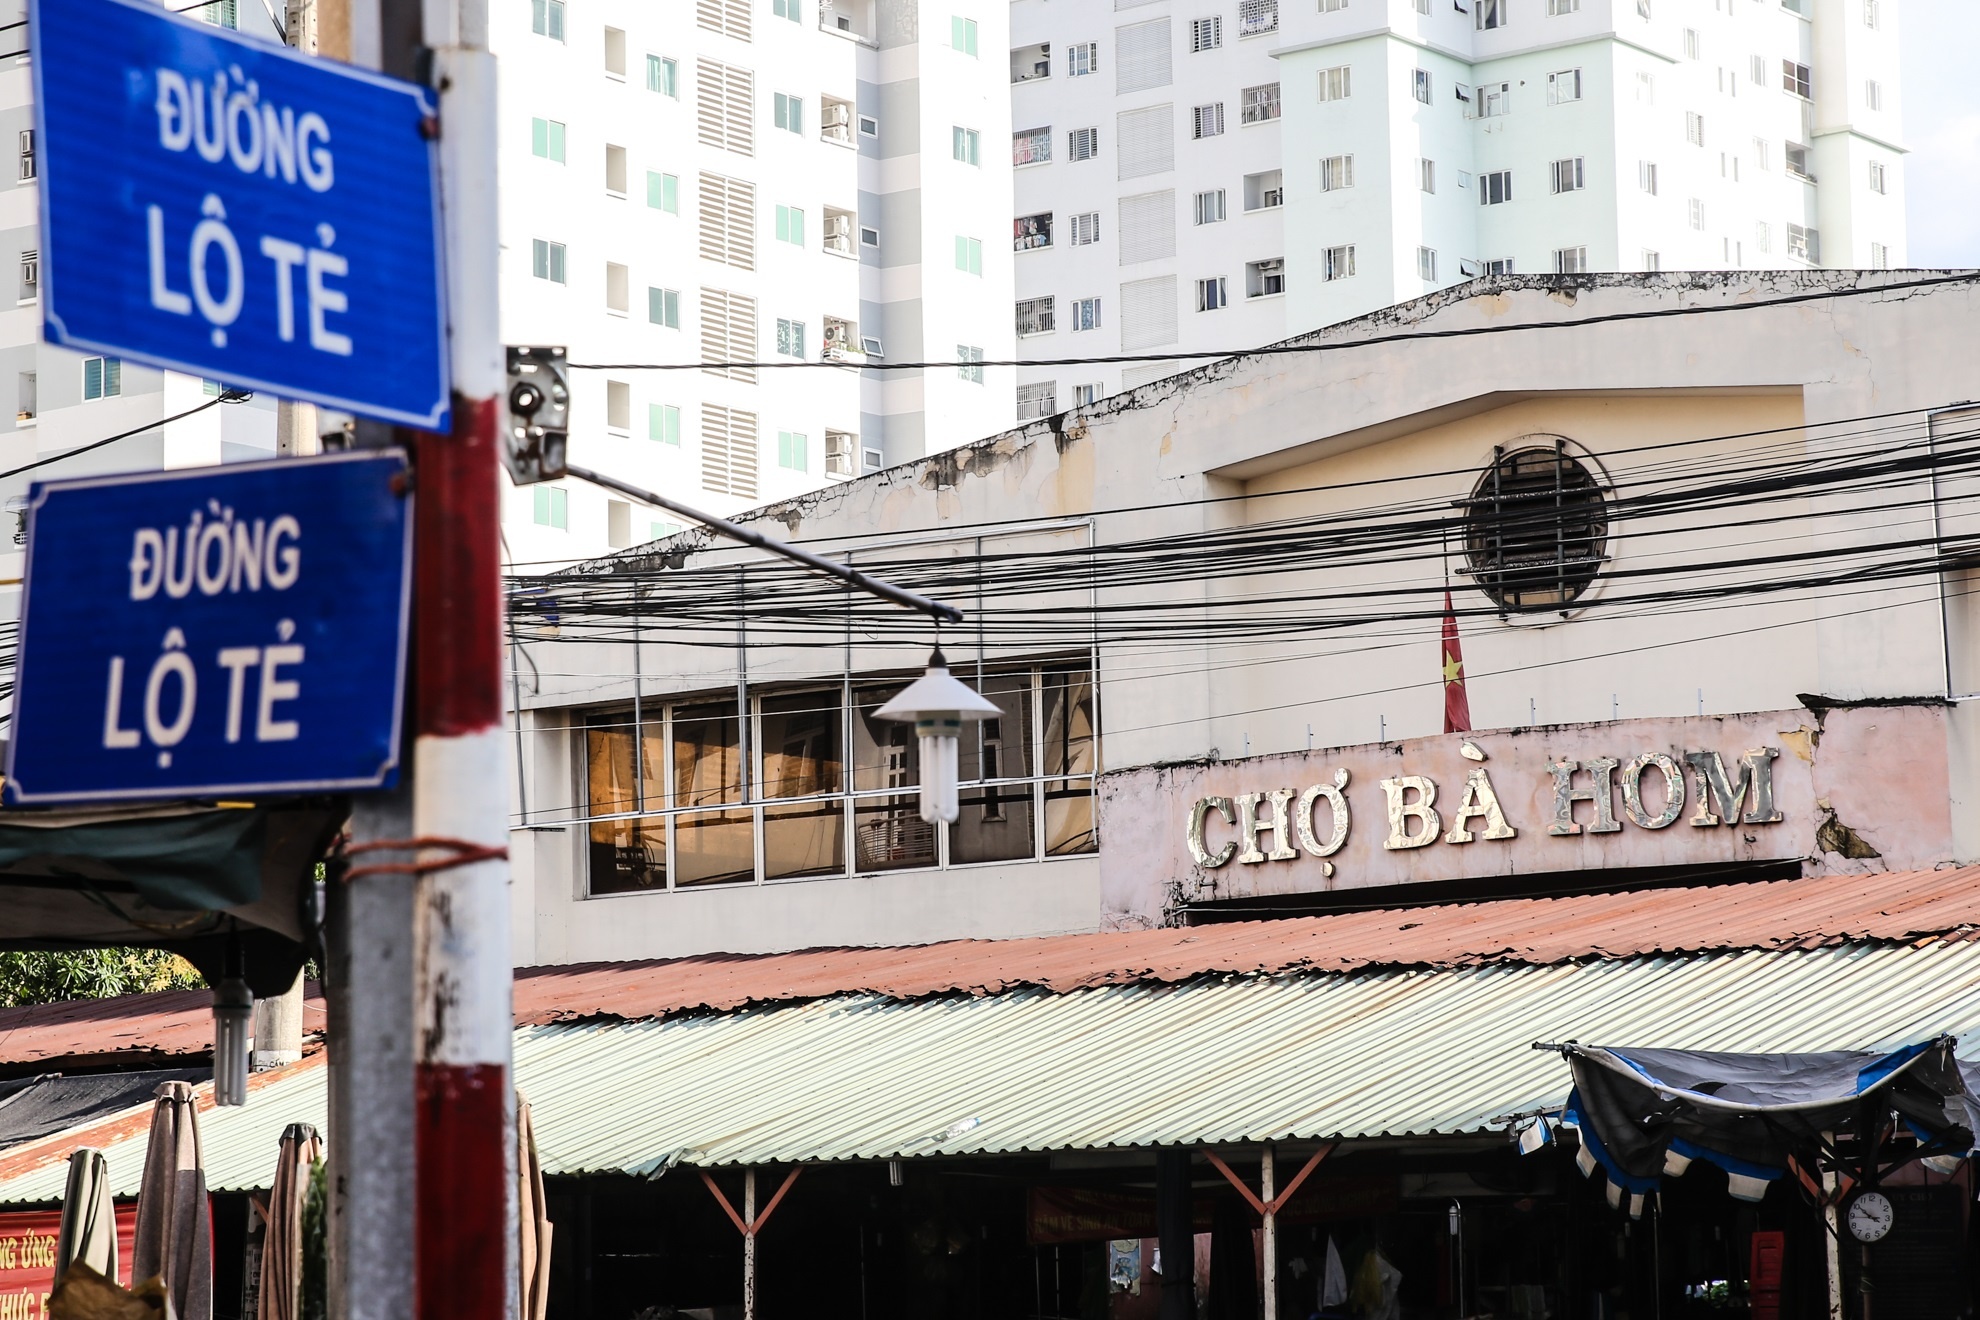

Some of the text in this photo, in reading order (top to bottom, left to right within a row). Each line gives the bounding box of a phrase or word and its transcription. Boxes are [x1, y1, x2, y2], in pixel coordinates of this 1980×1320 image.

[155, 63, 335, 193] ĐƯỜNG
[147, 193, 353, 356] LỘ TẺ
[129, 499, 301, 600] ĐƯỜNG
[103, 618, 304, 769] LỘ TẺ
[1186, 741, 1784, 878] CHỢ BÀ HOM
[21, 1228, 56, 1268] ỨNG
[1874, 1230, 1880, 1238] 5
